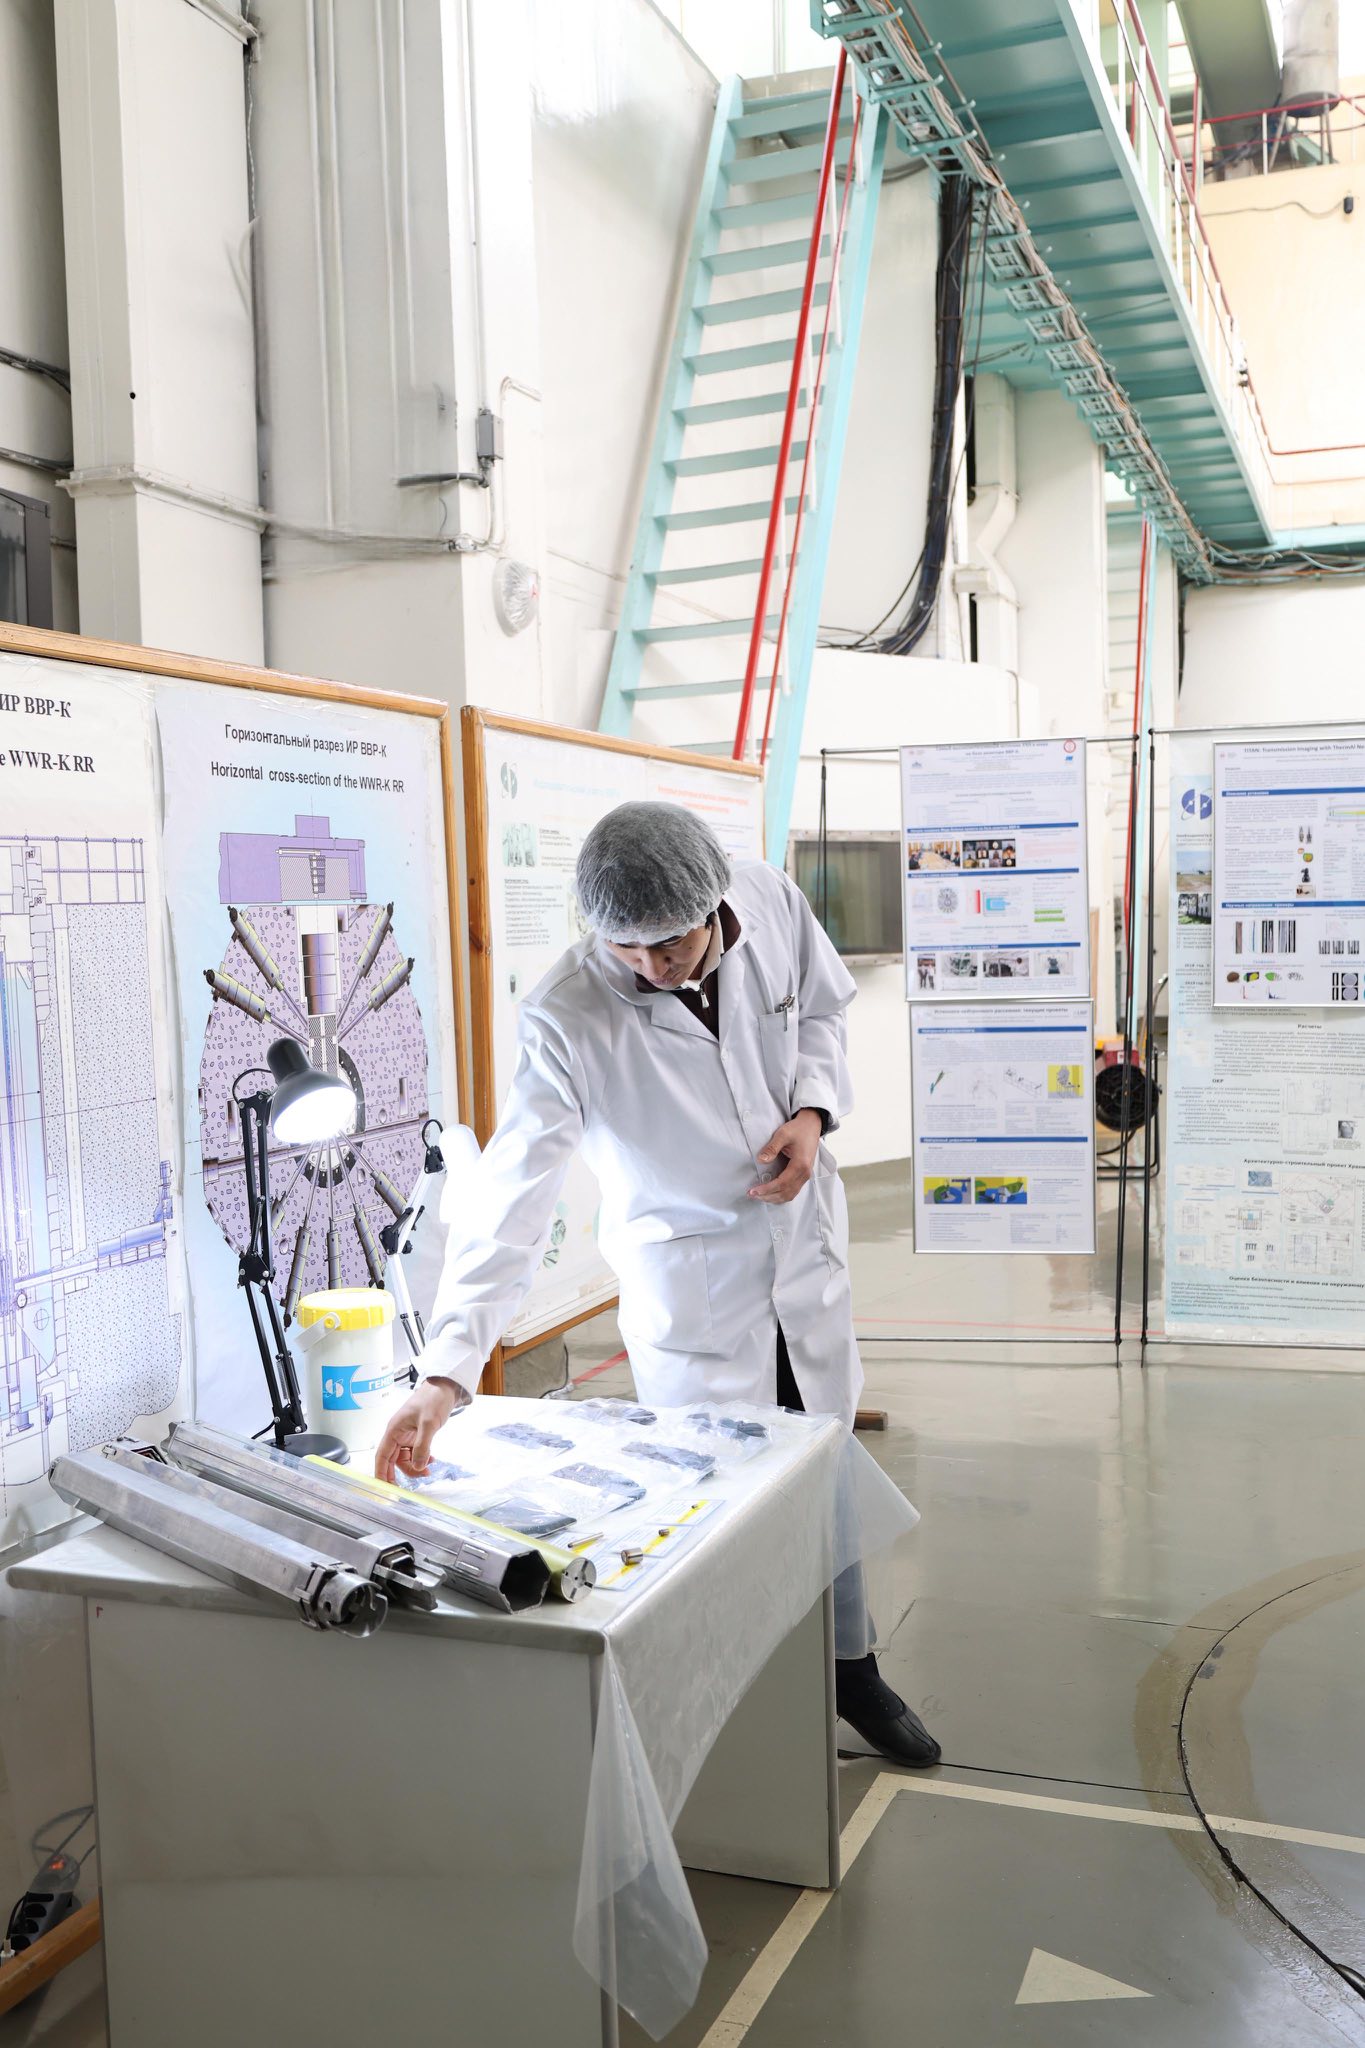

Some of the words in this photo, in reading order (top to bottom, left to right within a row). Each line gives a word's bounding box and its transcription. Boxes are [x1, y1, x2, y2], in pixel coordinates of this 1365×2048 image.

[24, 696, 72, 718] ВВР-К
[225, 723, 311, 748] Горизонтальный
[313, 738, 344, 754] разрез
[346, 740, 359, 754] ИР
[360, 741, 387, 758] ВВР-К
[8, 749, 71, 772] WWR-K
[73, 755, 95, 773] RR
[211, 761, 264, 780] Horizontal
[268, 769, 332, 787] cross-section
[333, 774, 342, 787] of
[344, 774, 358, 788] the
[359, 776, 391, 792] WWR-K
[392, 779, 405, 793] RR
